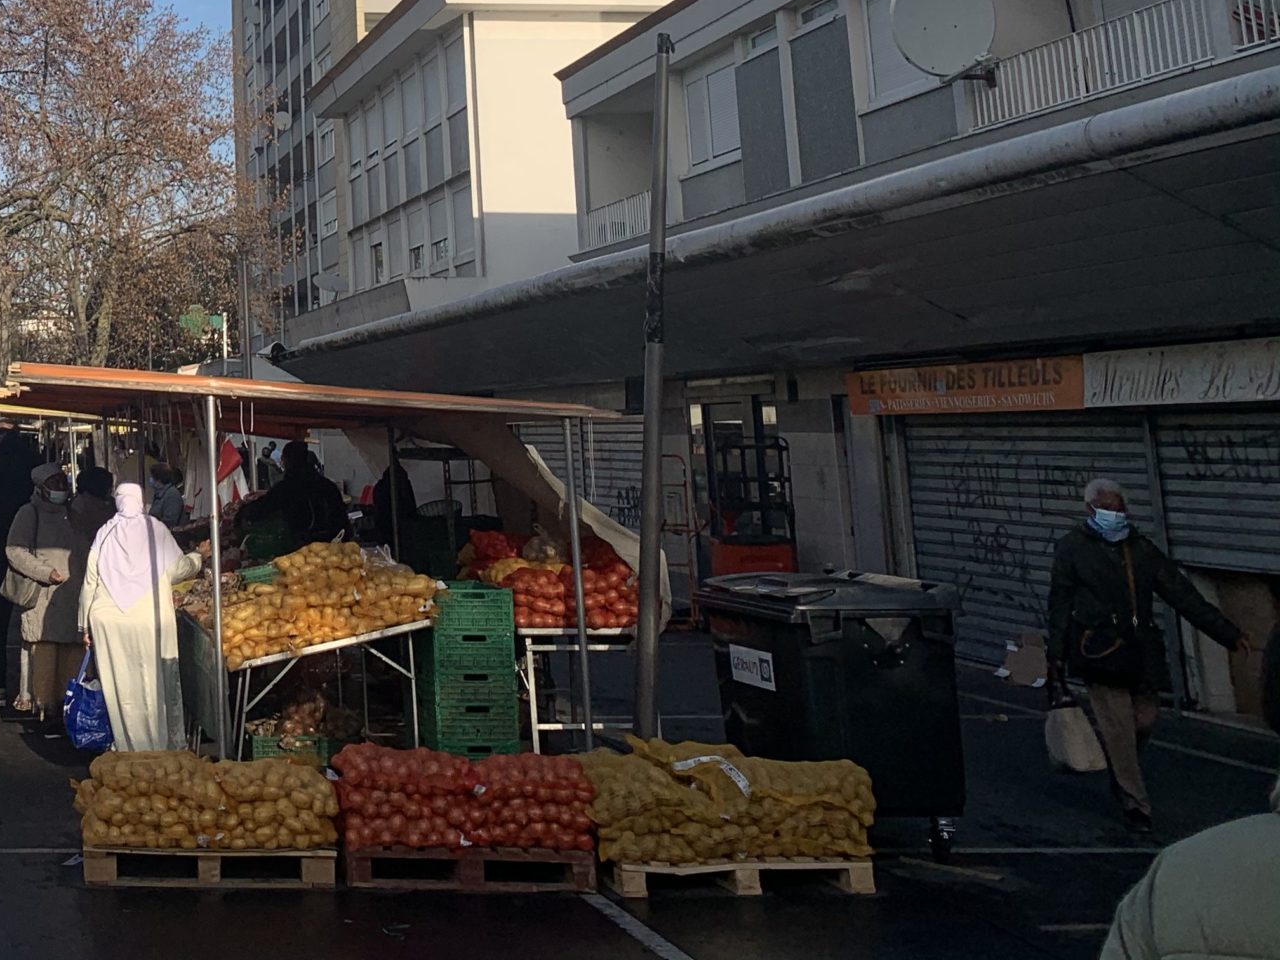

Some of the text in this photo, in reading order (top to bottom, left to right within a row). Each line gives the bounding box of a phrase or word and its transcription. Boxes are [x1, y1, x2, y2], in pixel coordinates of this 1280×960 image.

[859, 361, 1065, 395] LE FOURNIL DES TILLEULS
